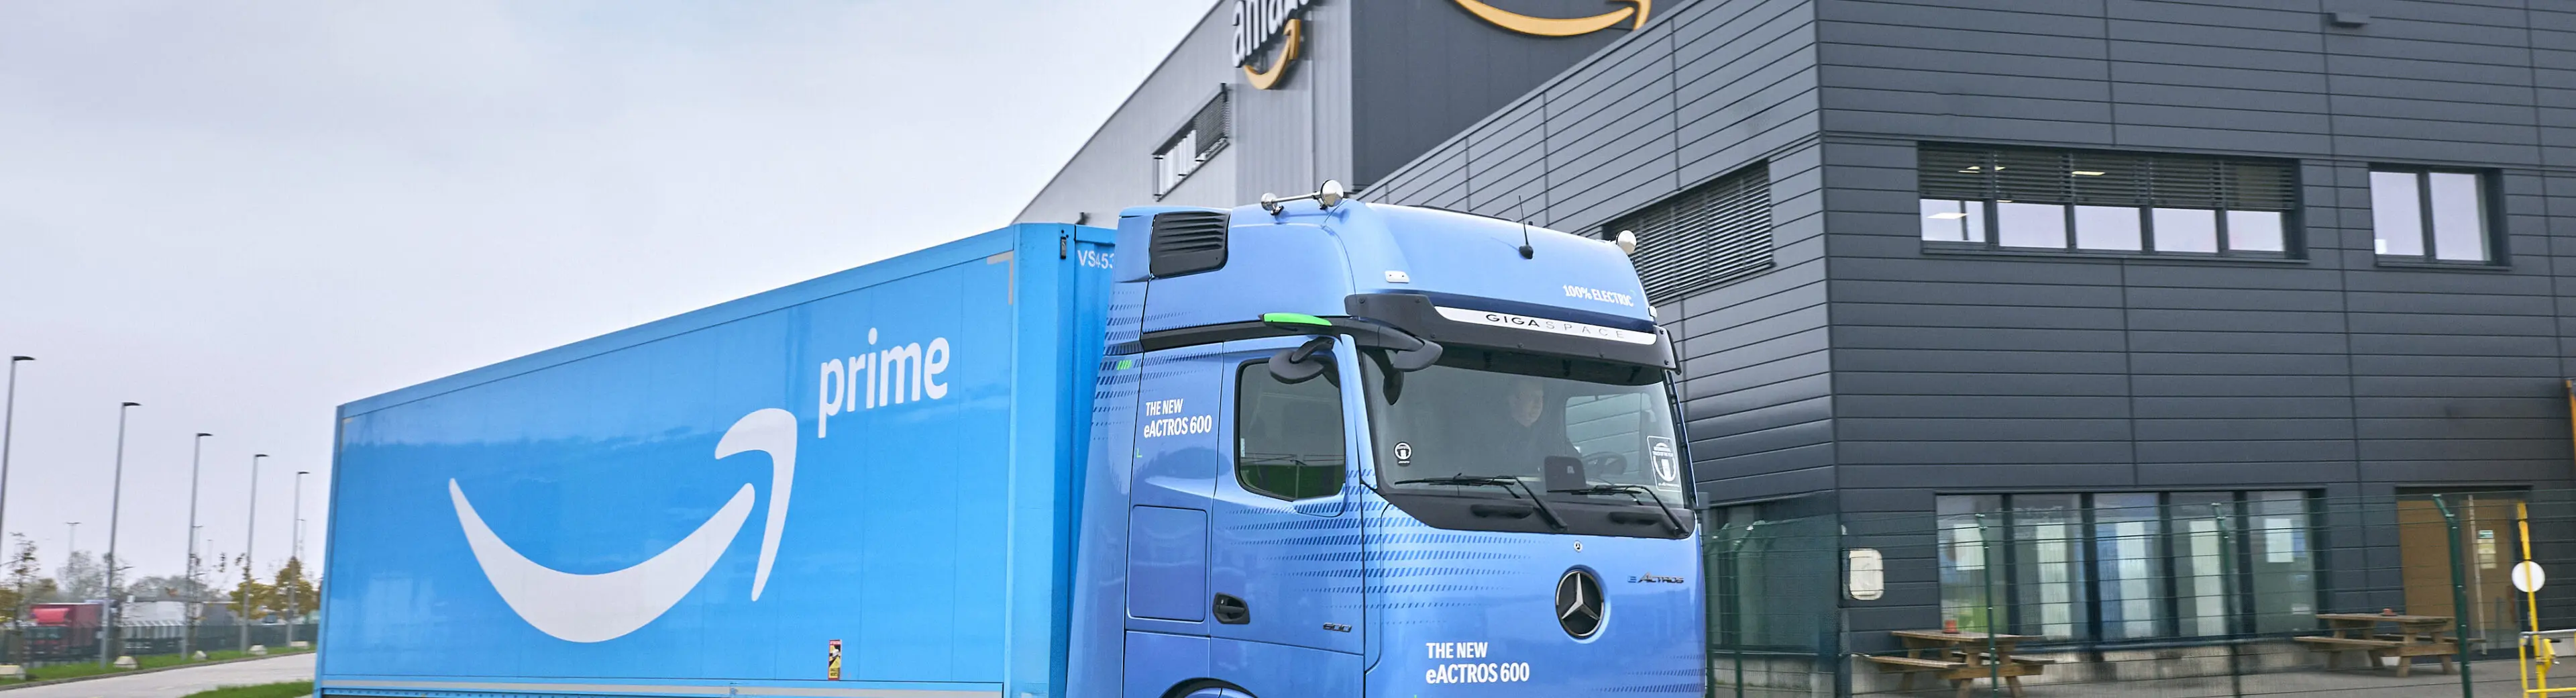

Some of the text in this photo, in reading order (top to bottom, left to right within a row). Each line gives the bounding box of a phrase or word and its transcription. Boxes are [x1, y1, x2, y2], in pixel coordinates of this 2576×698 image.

[1562, 285, 1634, 307] 100% ELECTRIC
[818, 327, 950, 438] prime
[1145, 398, 1183, 416] THE NEW
[1144, 415, 1212, 438] eACTROS 600
[1426, 642, 1488, 659] THE NEW
[1426, 662, 1529, 684] eACTROS 600
